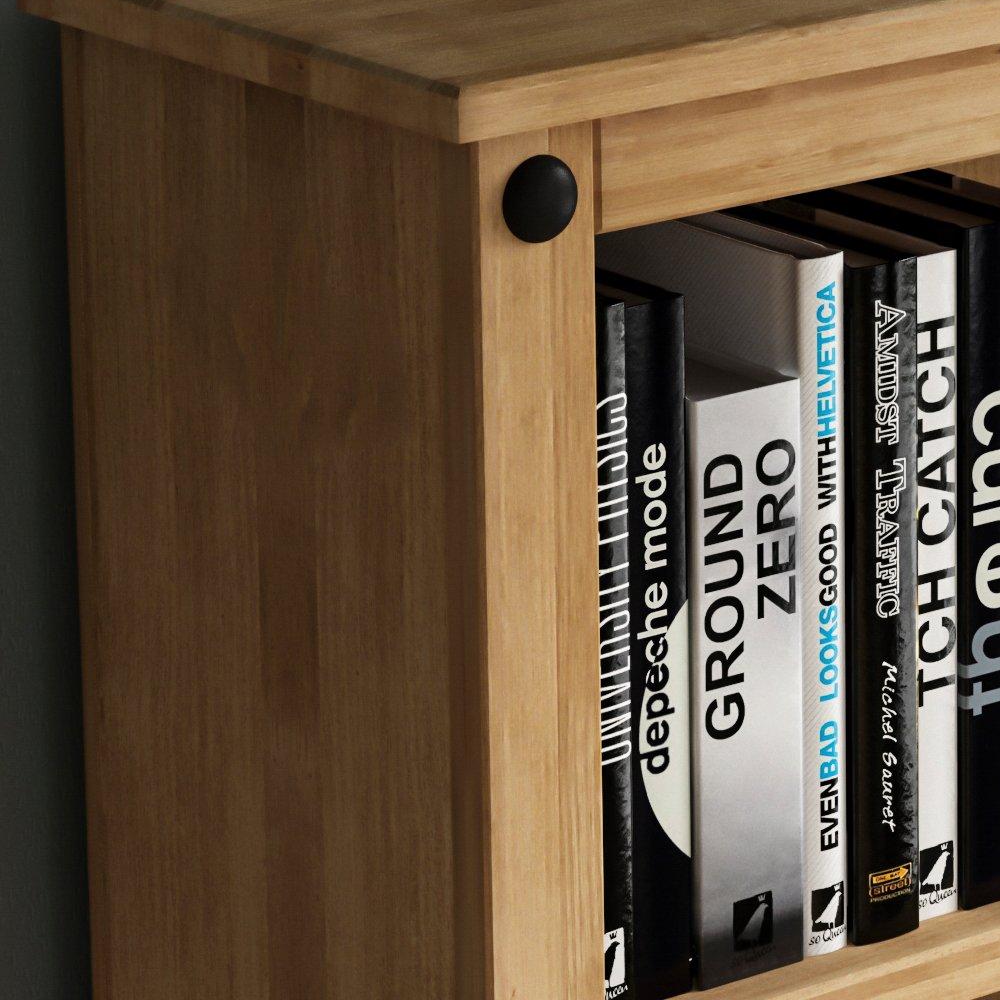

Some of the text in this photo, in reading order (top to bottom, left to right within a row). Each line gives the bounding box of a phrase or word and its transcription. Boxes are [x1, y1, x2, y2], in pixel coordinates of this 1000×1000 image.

[634, 441, 675, 775] depeche mode
[703, 453, 746, 740] GROUND
[755, 438, 797, 619] ZERO
[875, 299, 906, 619] AMIDST TRAFFIC
[916, 315, 957, 708] TCH CATCH
[881, 661, 898, 833] Michel Sauret
